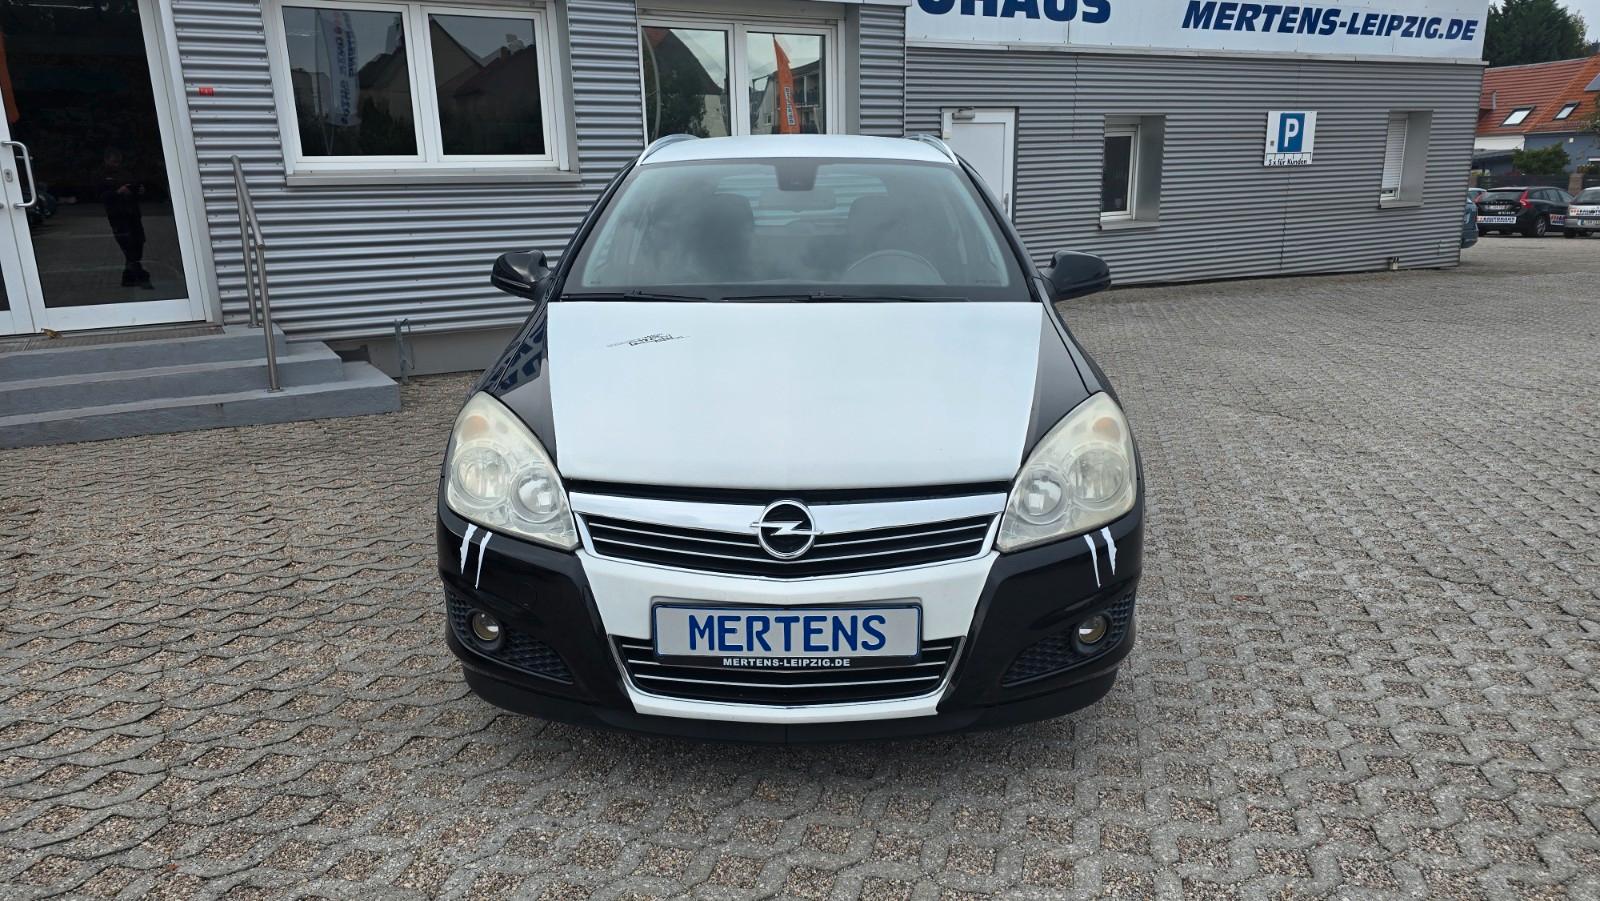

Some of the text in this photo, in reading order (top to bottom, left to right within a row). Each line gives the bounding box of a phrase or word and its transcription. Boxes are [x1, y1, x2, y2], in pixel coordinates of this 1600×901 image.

[1181, 0, 1479, 41] MERTENS-LEIPZIG.DE
[1284, 118, 1299, 147] P
[689, 614, 886, 652] MERTENS
[723, 658, 850, 667] MERTENS-LEIPZIG.DE
